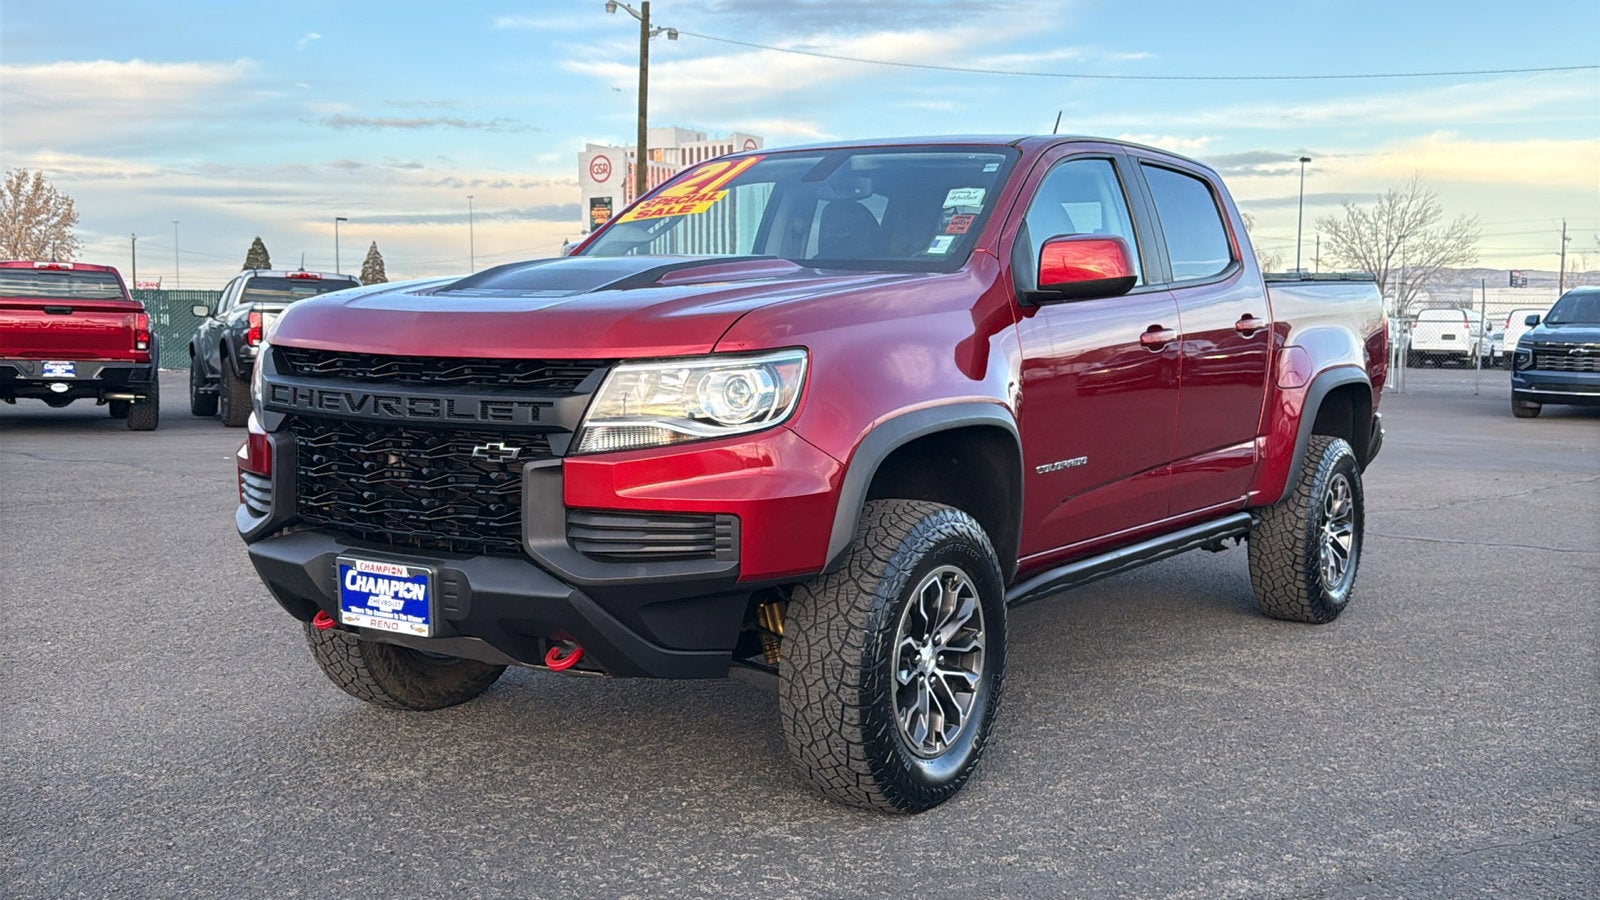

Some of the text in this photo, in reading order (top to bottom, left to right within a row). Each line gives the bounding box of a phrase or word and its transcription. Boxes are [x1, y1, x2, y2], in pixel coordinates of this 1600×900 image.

[593, 163, 608, 175] GSR
[656, 156, 759, 197] 21
[640, 191, 719, 209] SPECIAL
[633, 204, 698, 220] SALE
[270, 384, 554, 422] CHEVROLET
[1035, 456, 1088, 474] COLORADO
[360, 563, 403, 575] CHAMPION
[345, 569, 426, 601] CHAMPION
[369, 598, 402, 609] CHEVROLET
[369, 618, 399, 630] RENO
